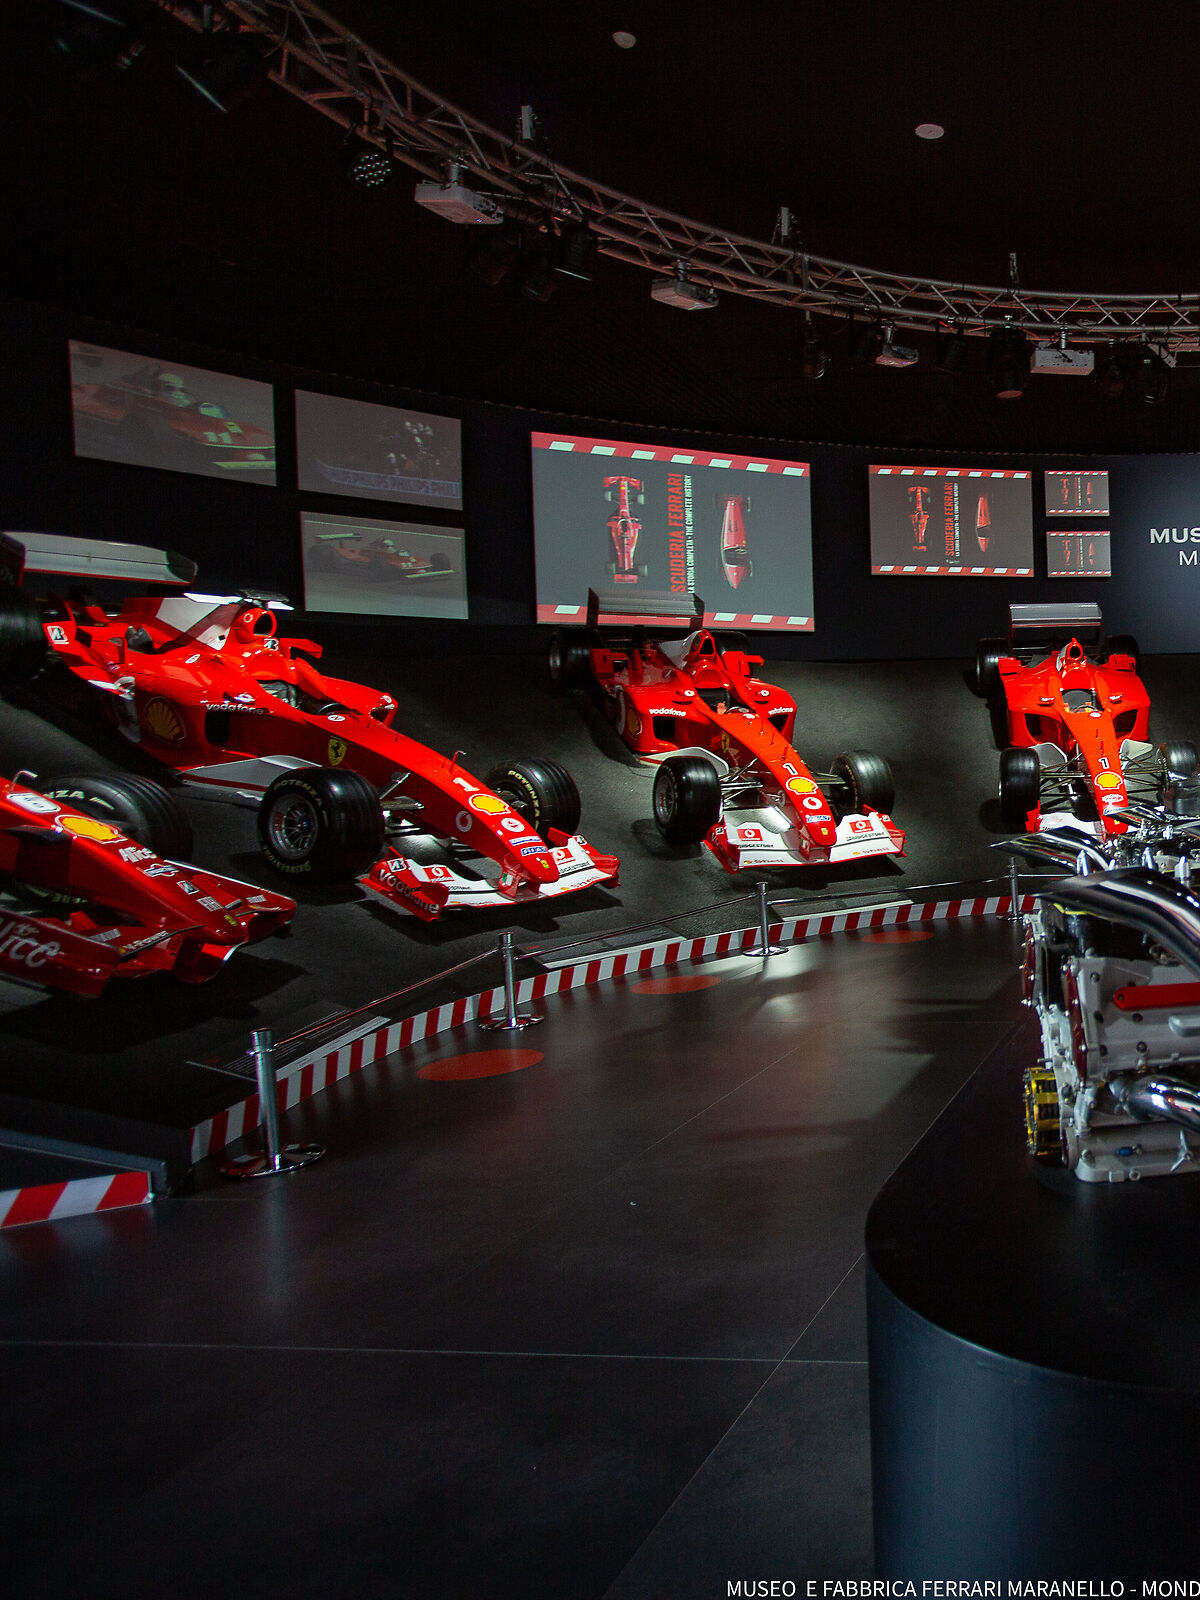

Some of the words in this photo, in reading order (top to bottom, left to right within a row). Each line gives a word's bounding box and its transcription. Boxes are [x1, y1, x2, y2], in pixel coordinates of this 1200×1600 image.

[684, 475, 692, 498] HISTORY
[667, 473, 683, 527] FERRARI
[944, 482, 953, 516] FERRARI
[684, 498, 693, 525] COMPLETE
[945, 518, 955, 556] SCUDERIA
[669, 531, 686, 592] SCUDERIA
[686, 540, 695, 566] COMPLETA
[687, 566, 695, 586] STORIA
[206, 703, 265, 714] vodafone
[649, 707, 687, 717] vodafone
[768, 706, 794, 716] vodafone
[782, 763, 799, 776] 1
[453, 777, 480, 792] 1
